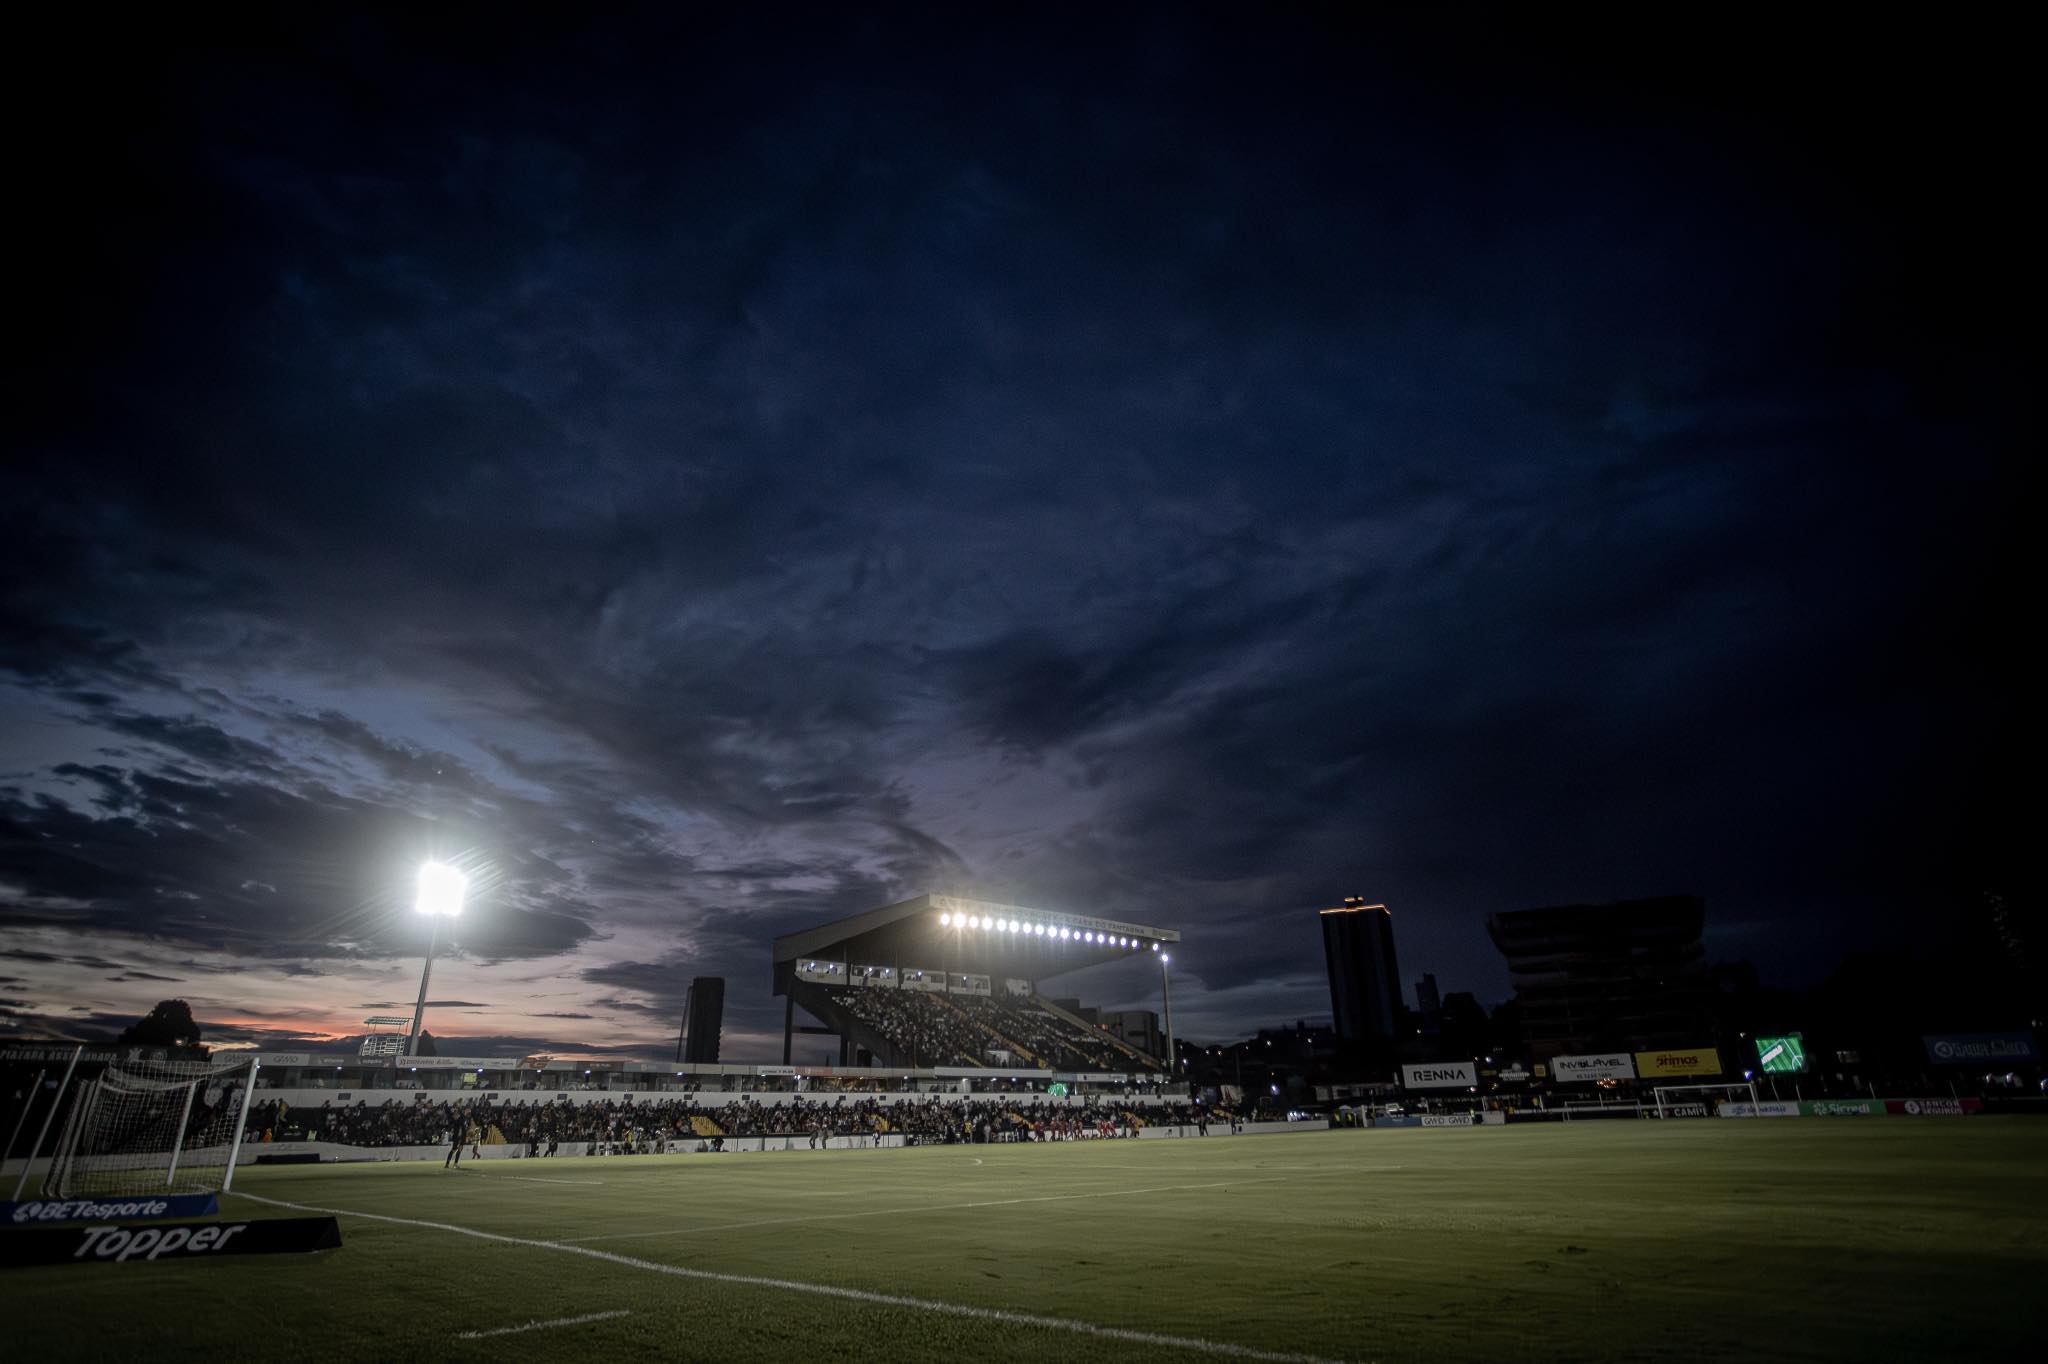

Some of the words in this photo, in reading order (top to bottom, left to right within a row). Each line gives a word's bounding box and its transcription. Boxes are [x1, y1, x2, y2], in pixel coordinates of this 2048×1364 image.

[1413, 1070, 1466, 1081] RENNA
[1828, 1103, 1870, 1115] Sicredi
[36, 1200, 168, 1220] BETesporte
[73, 1225, 248, 1262] Topper
